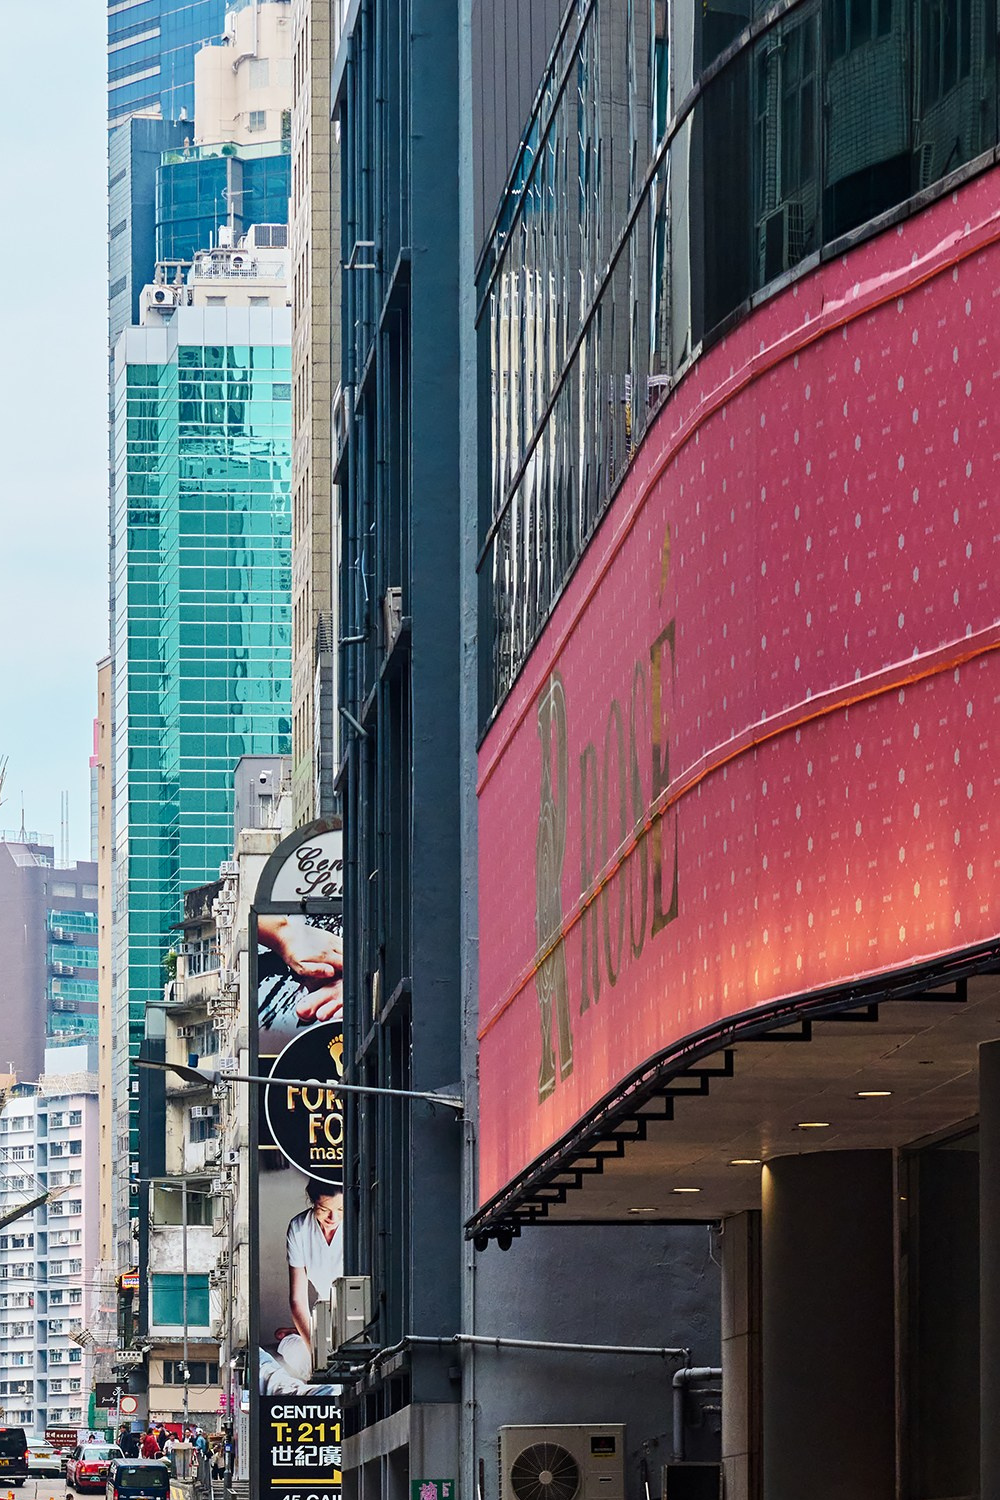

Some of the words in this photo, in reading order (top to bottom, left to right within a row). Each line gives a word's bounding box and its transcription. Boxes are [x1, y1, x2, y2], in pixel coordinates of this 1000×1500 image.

[309, 1113, 343, 1146] FO
[310, 1147, 343, 1160] mas
[270, 1405, 342, 1419] CENTUR
[270, 1422, 292, 1442] T:
[297, 1422, 341, 1442] 211
